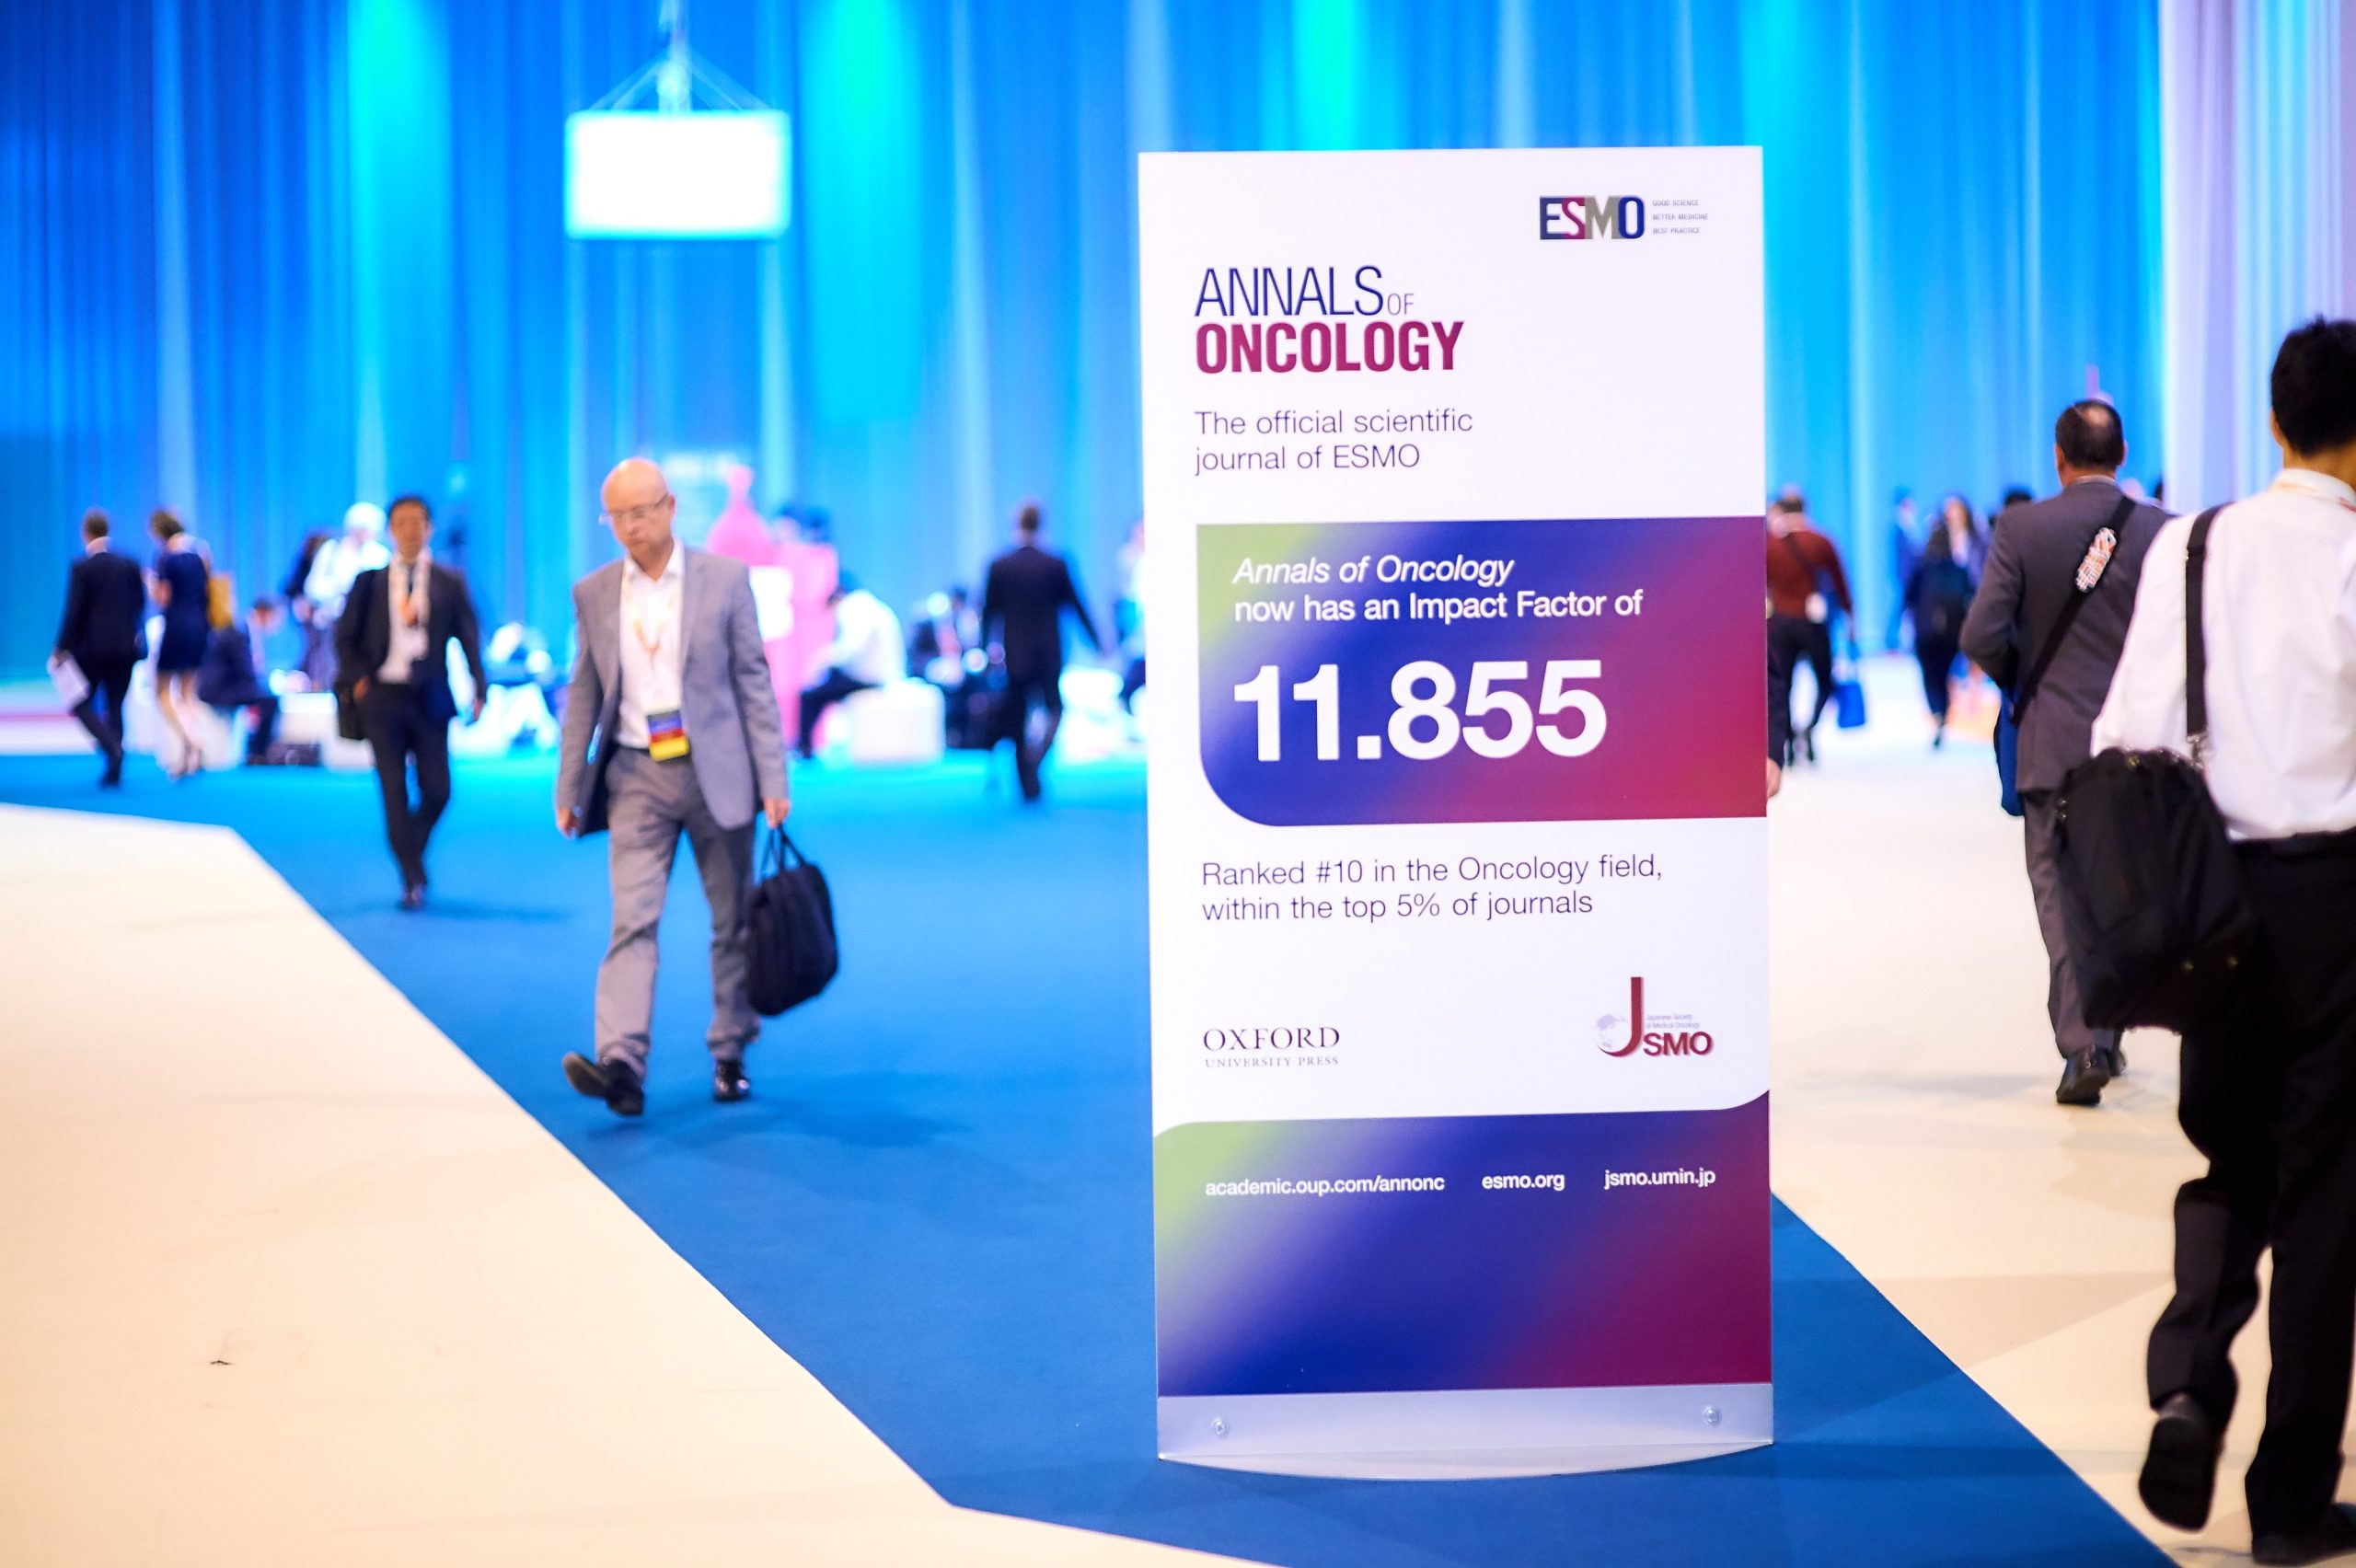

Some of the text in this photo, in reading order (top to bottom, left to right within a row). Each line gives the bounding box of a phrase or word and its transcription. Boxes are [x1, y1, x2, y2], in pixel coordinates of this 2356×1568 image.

[1540, 197, 1645, 240] ESMO
[1672, 199, 1700, 207] SCIENCE
[1194, 265, 1415, 317] ANNALS OF
[1195, 320, 1465, 375] ONCOLOGY
[1194, 408, 1473, 434] The official scientific
[1195, 444, 1420, 477] journal of ESMO
[1231, 554, 1516, 588] Annals of Oncology
[1233, 589, 1645, 625] now has an Impact Factor of
[1233, 659, 1607, 762] 11.855
[1202, 853, 1663, 886] Ranked #10 in the Oncology field,
[1202, 890, 1593, 924] within the top 5% of journals
[1203, 1027, 1340, 1051] OXFORD
[1205, 1055, 1339, 1068] UNIVERSITY PRESS
[1205, 1167, 1716, 1196] academic.oup.com/annonc esmo.org jsmo.umin.jp
